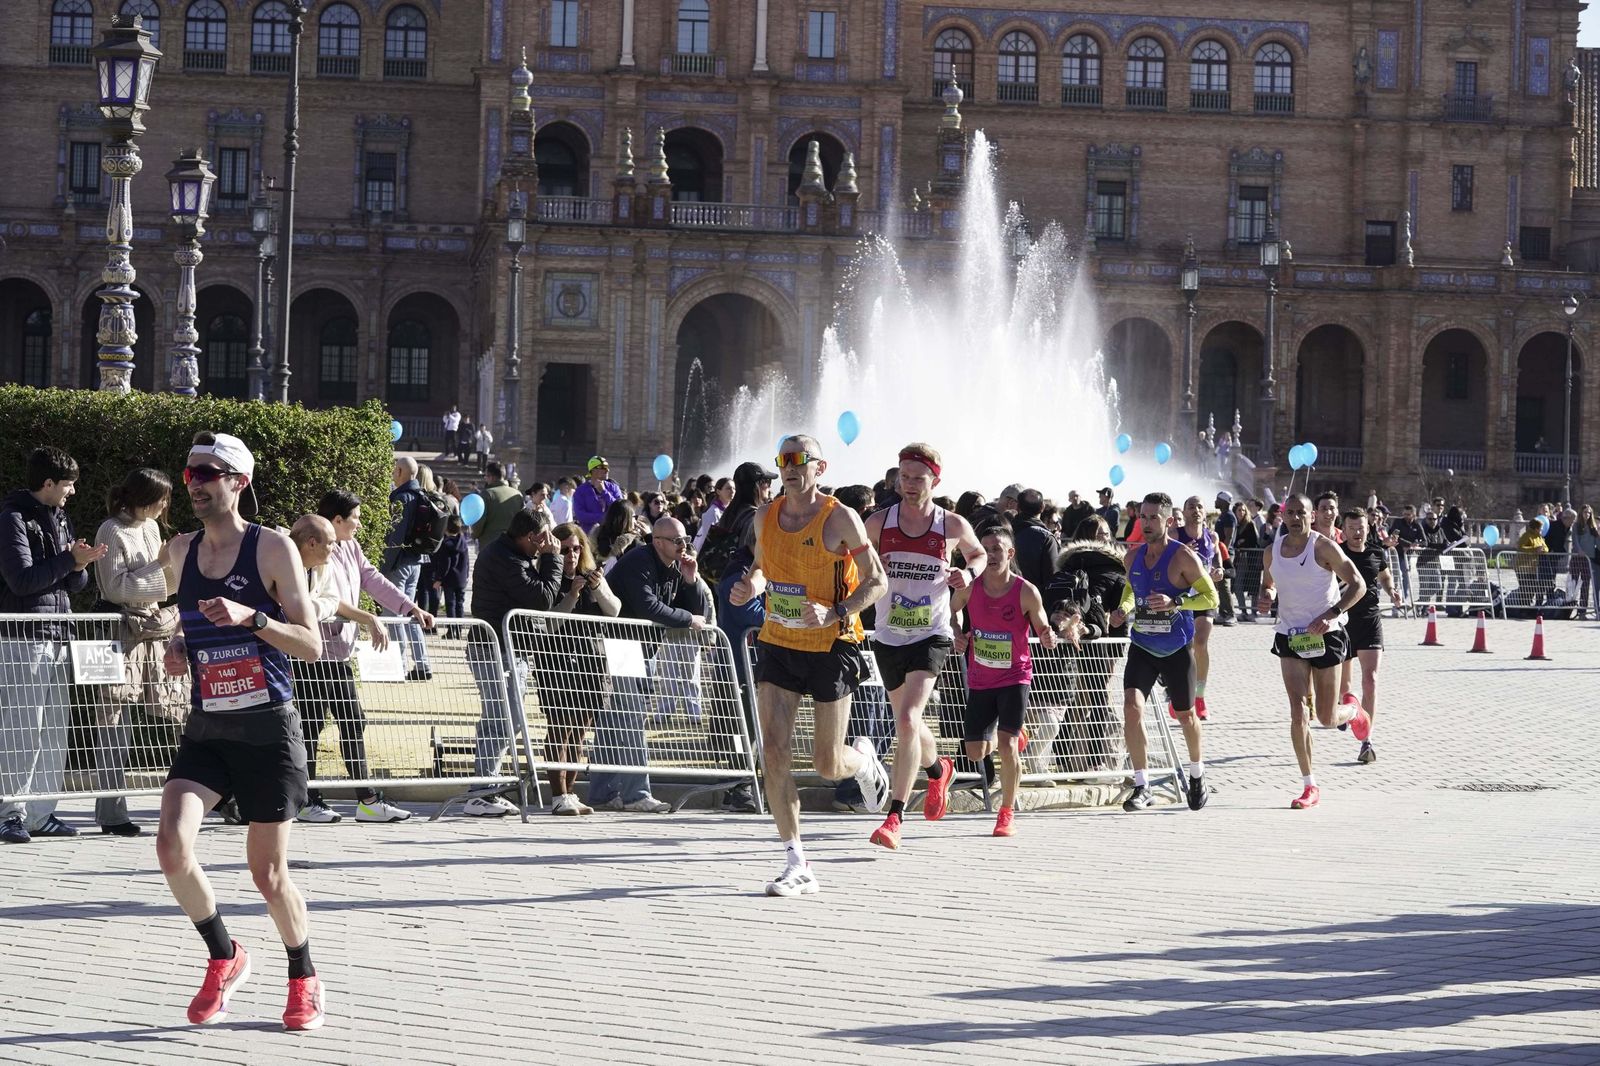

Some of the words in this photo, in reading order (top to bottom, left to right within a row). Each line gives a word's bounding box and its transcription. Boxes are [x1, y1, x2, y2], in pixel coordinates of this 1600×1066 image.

[887, 561, 941, 573] ATESHEAD
[775, 585, 801, 594] ZURICH
[774, 603, 802, 617] MACIN
[890, 616, 929, 626] DOUGLAS
[983, 632, 1007, 640] ZURICH
[85, 647, 113, 664] AMS
[212, 646, 249, 660] ZURICH
[974, 646, 1011, 660] TOMASIYO
[218, 667, 237, 678] 1440
[210, 677, 256, 696] VEDERE
